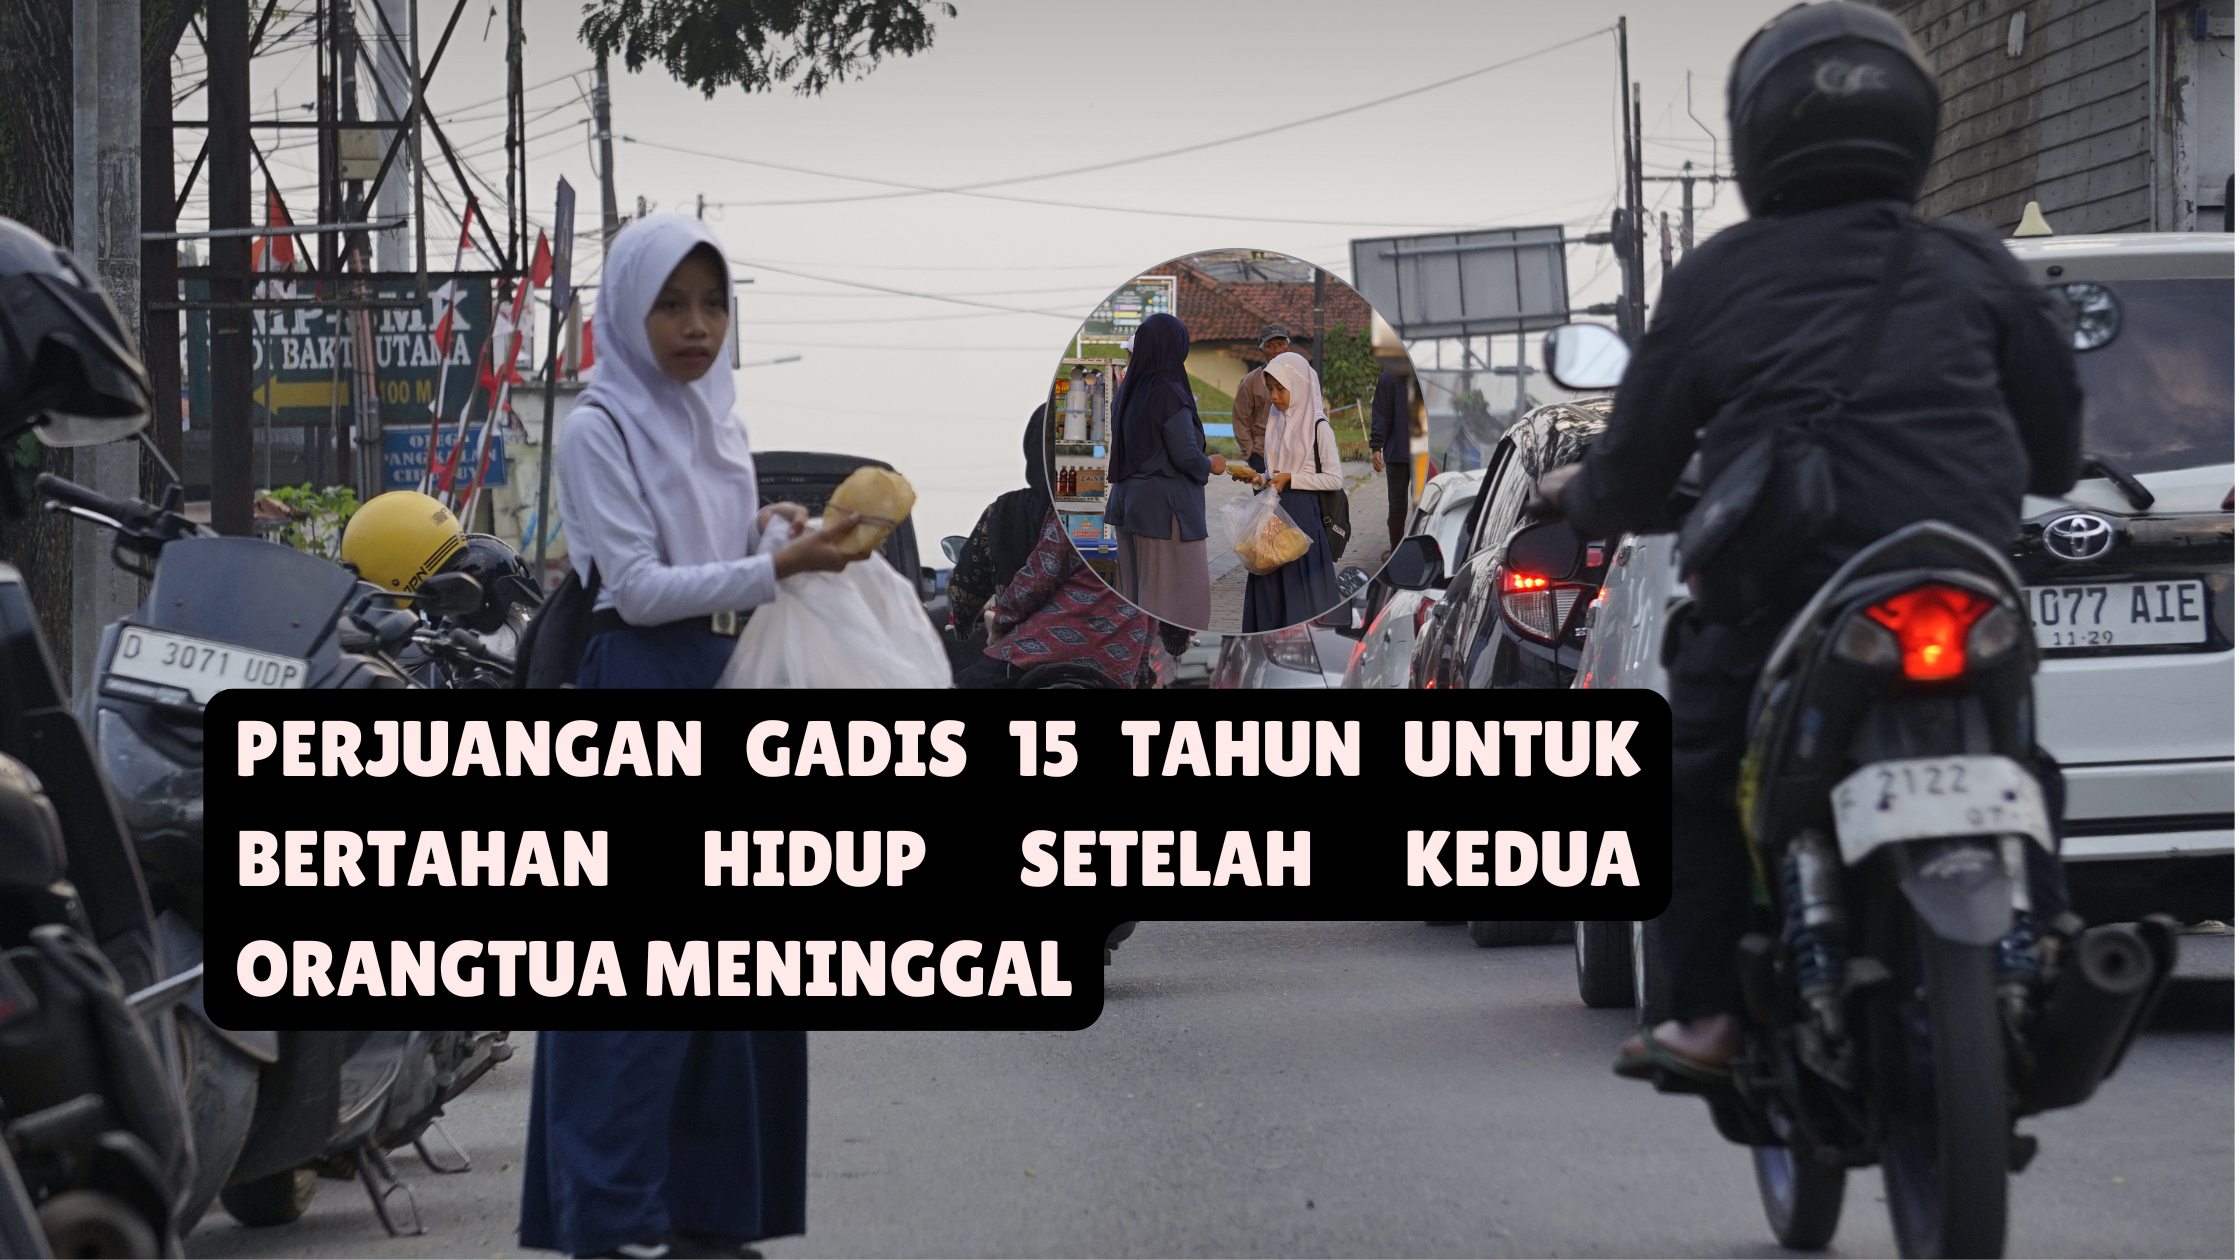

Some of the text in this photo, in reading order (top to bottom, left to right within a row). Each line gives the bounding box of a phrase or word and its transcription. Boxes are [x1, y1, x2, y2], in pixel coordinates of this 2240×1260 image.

[416, 380, 432, 402] M
[2130, 583, 2199, 624] AIE
[123, 635, 297, 688] D 3071 UDP
[1877, 765, 1969, 802] 2122
